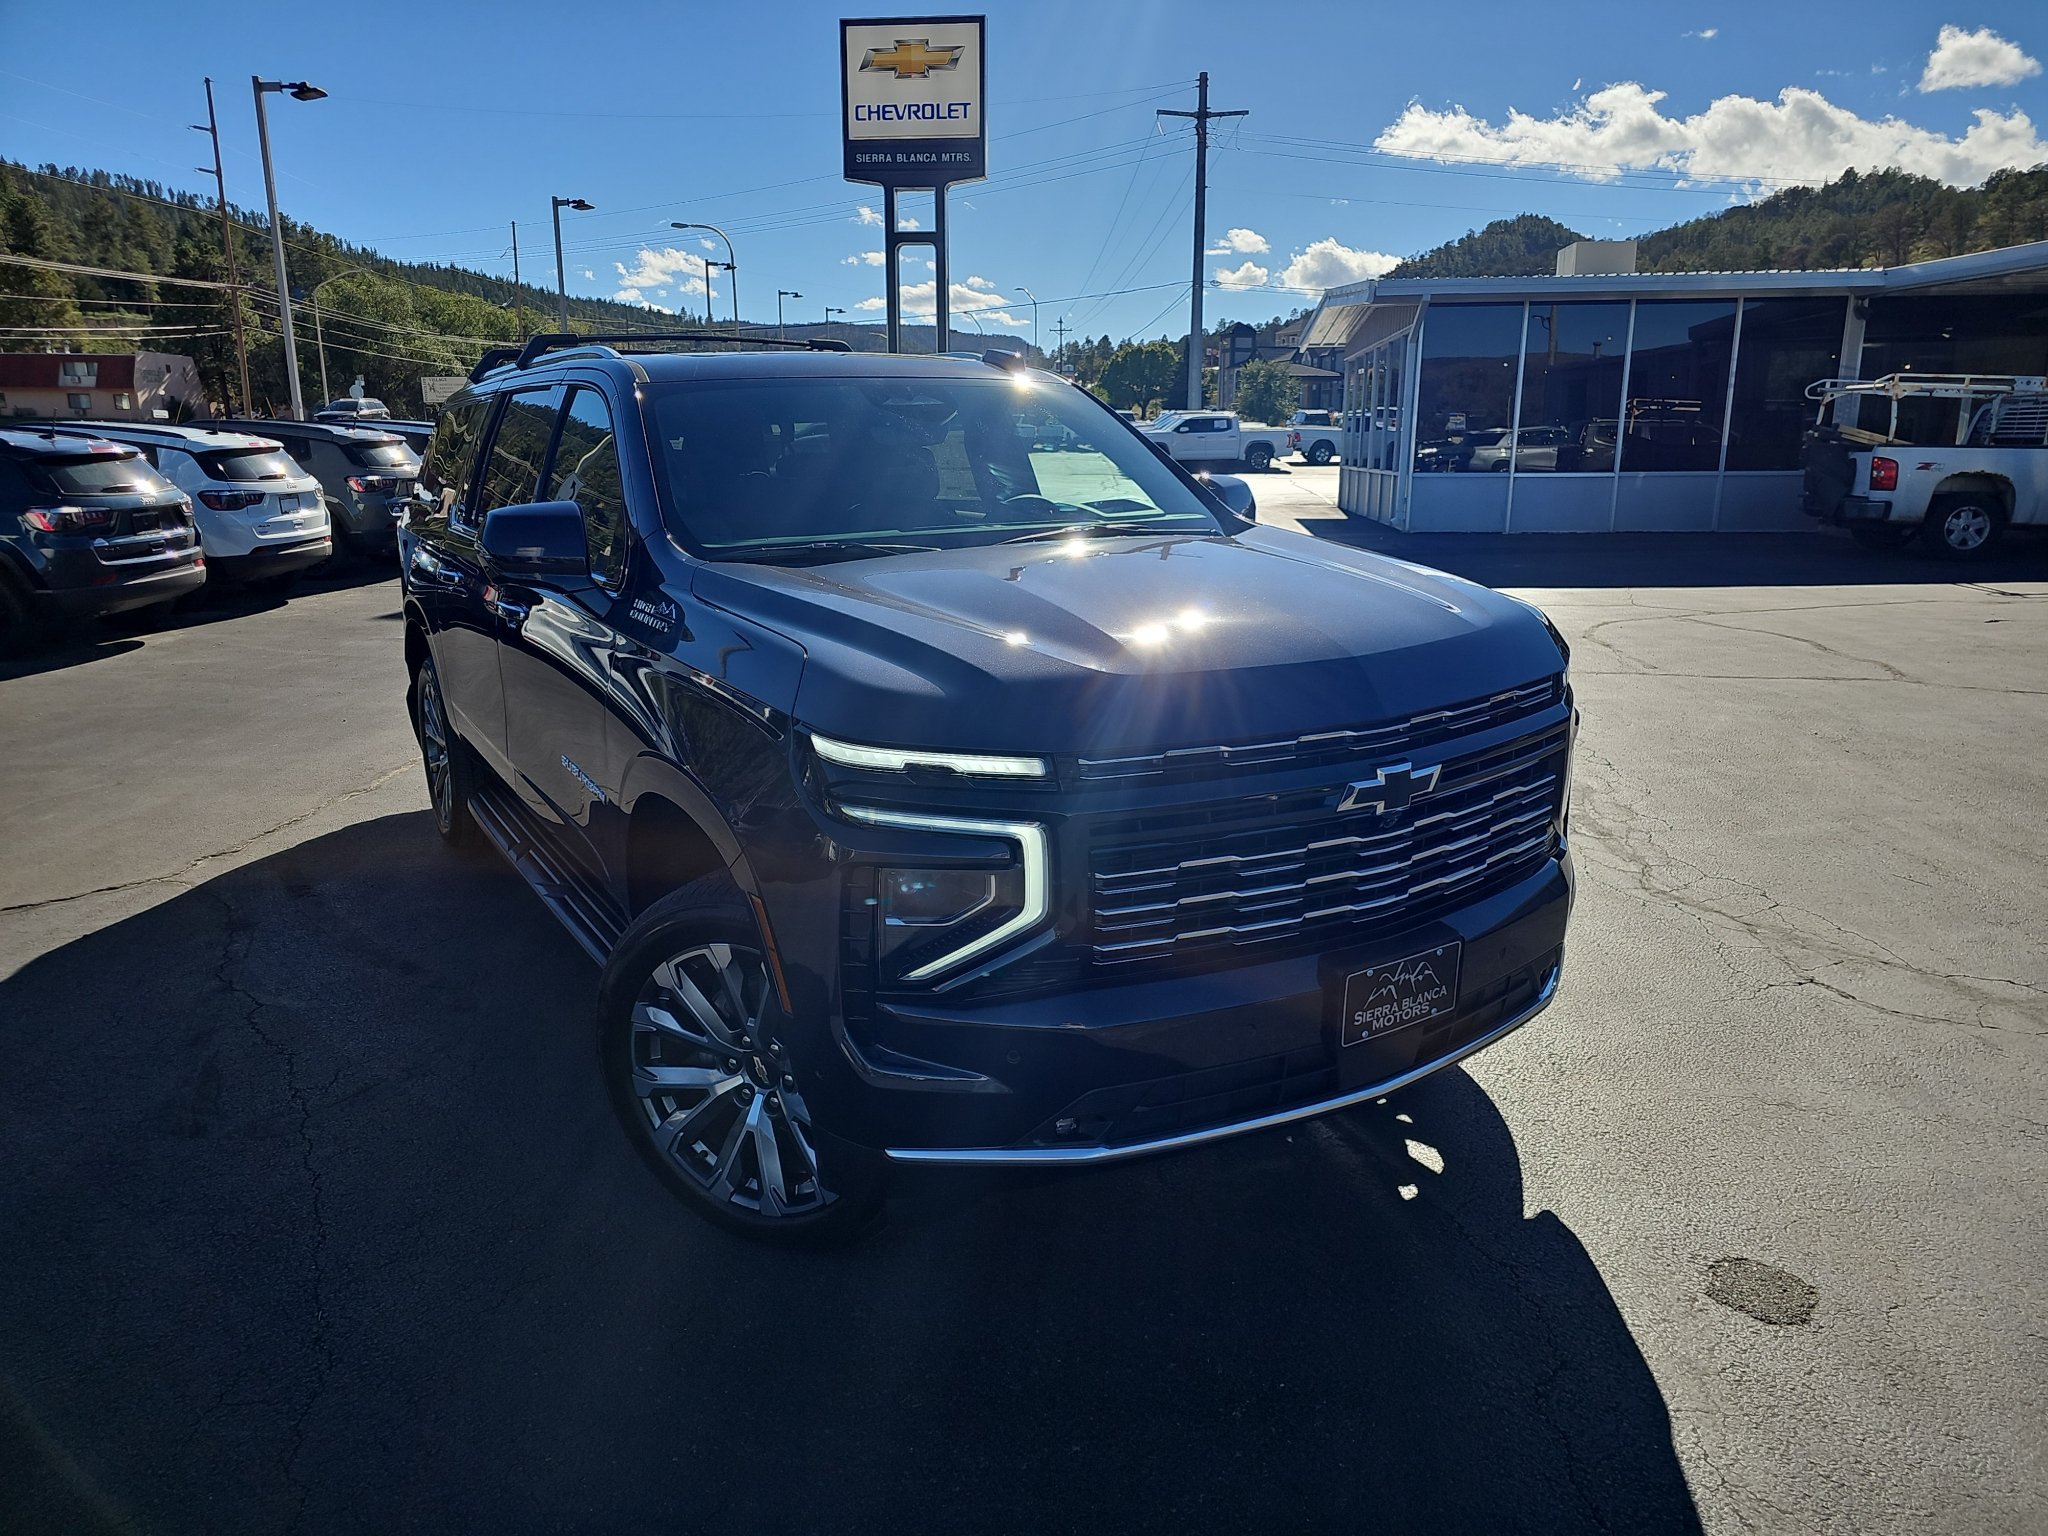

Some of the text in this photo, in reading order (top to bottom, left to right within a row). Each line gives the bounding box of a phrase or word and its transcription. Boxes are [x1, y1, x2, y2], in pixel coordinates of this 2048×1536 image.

[855, 103, 971, 121] CHEVROLET
[856, 153, 972, 163] SIERRA BLANCA MTRS.
[633, 598, 656, 614] HIGH
[630, 609, 672, 633] COUNTRY
[1353, 985, 1448, 1026] SIERRA BLANCA
[1372, 1002, 1430, 1031] MOTORS
